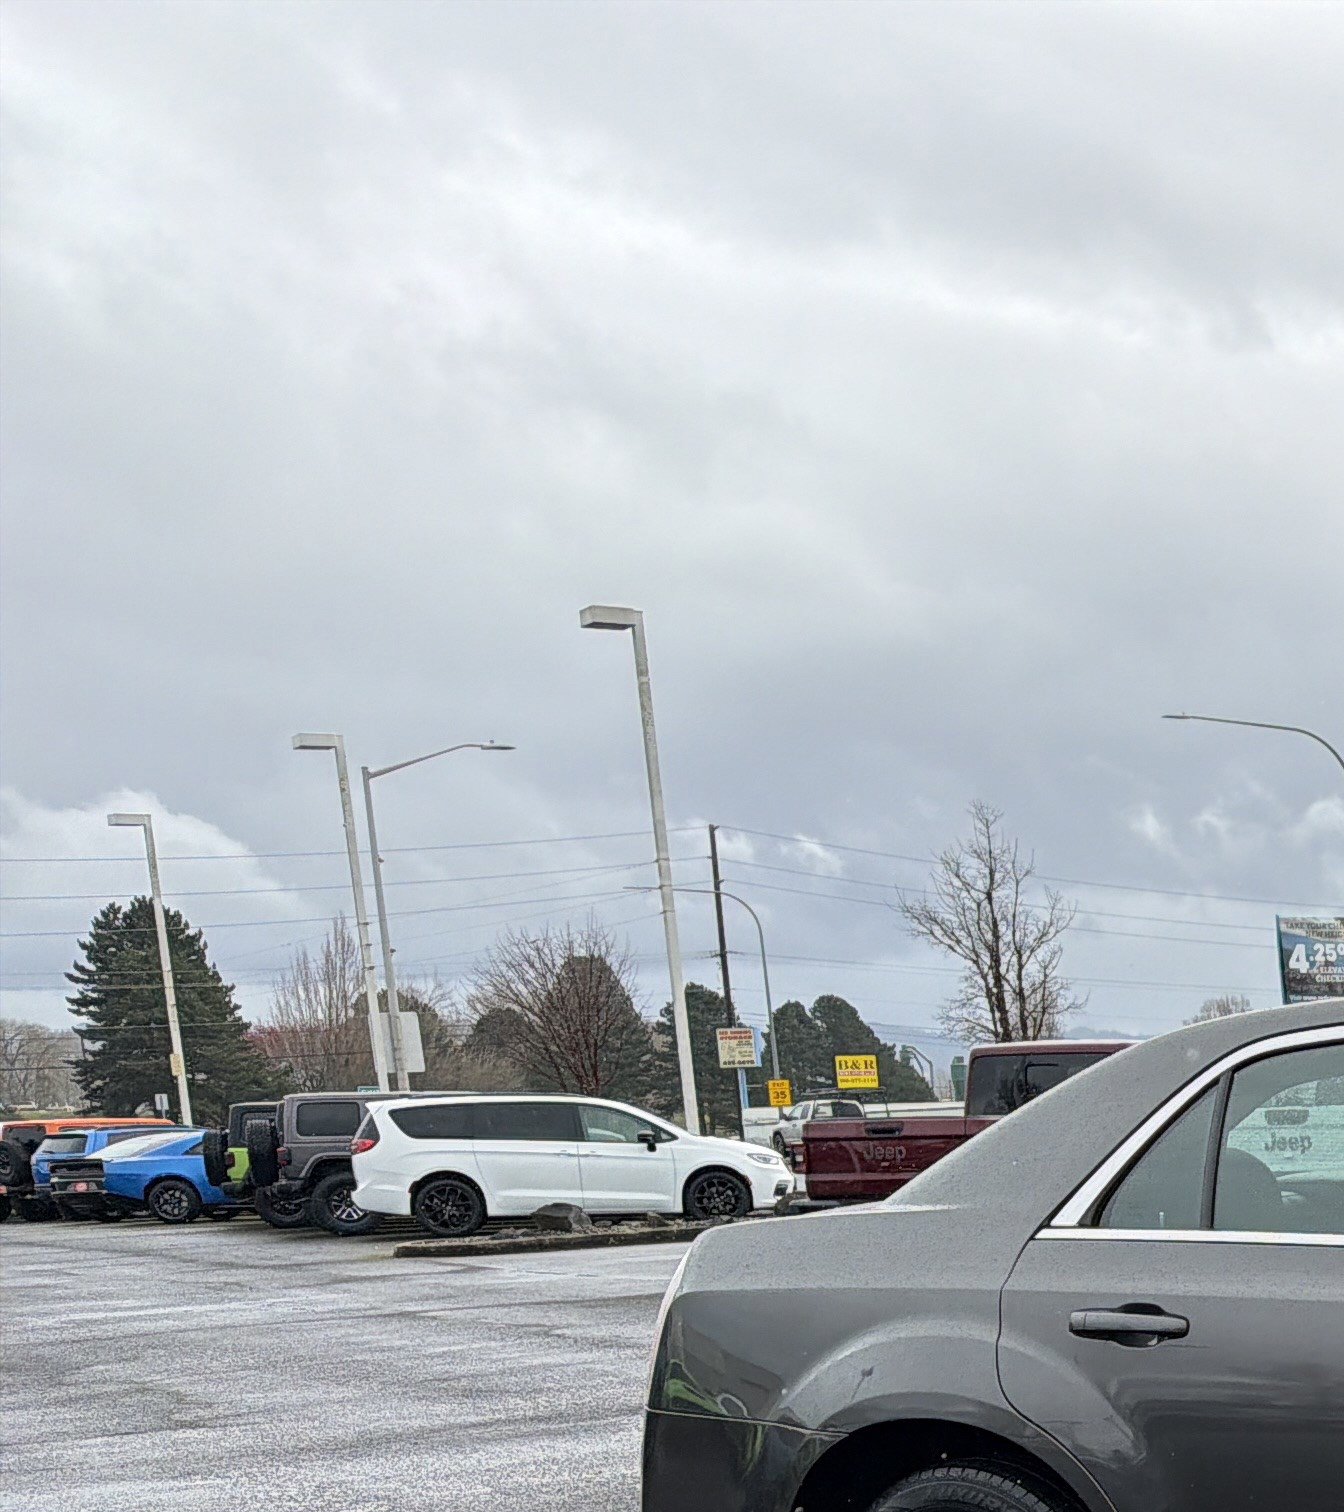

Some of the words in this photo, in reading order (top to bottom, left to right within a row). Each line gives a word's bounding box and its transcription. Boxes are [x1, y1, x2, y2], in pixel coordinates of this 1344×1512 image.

[772, 1090, 787, 1100] 35
[863, 1141, 907, 1164] Jeep
[1264, 1132, 1313, 1155] Jeep
